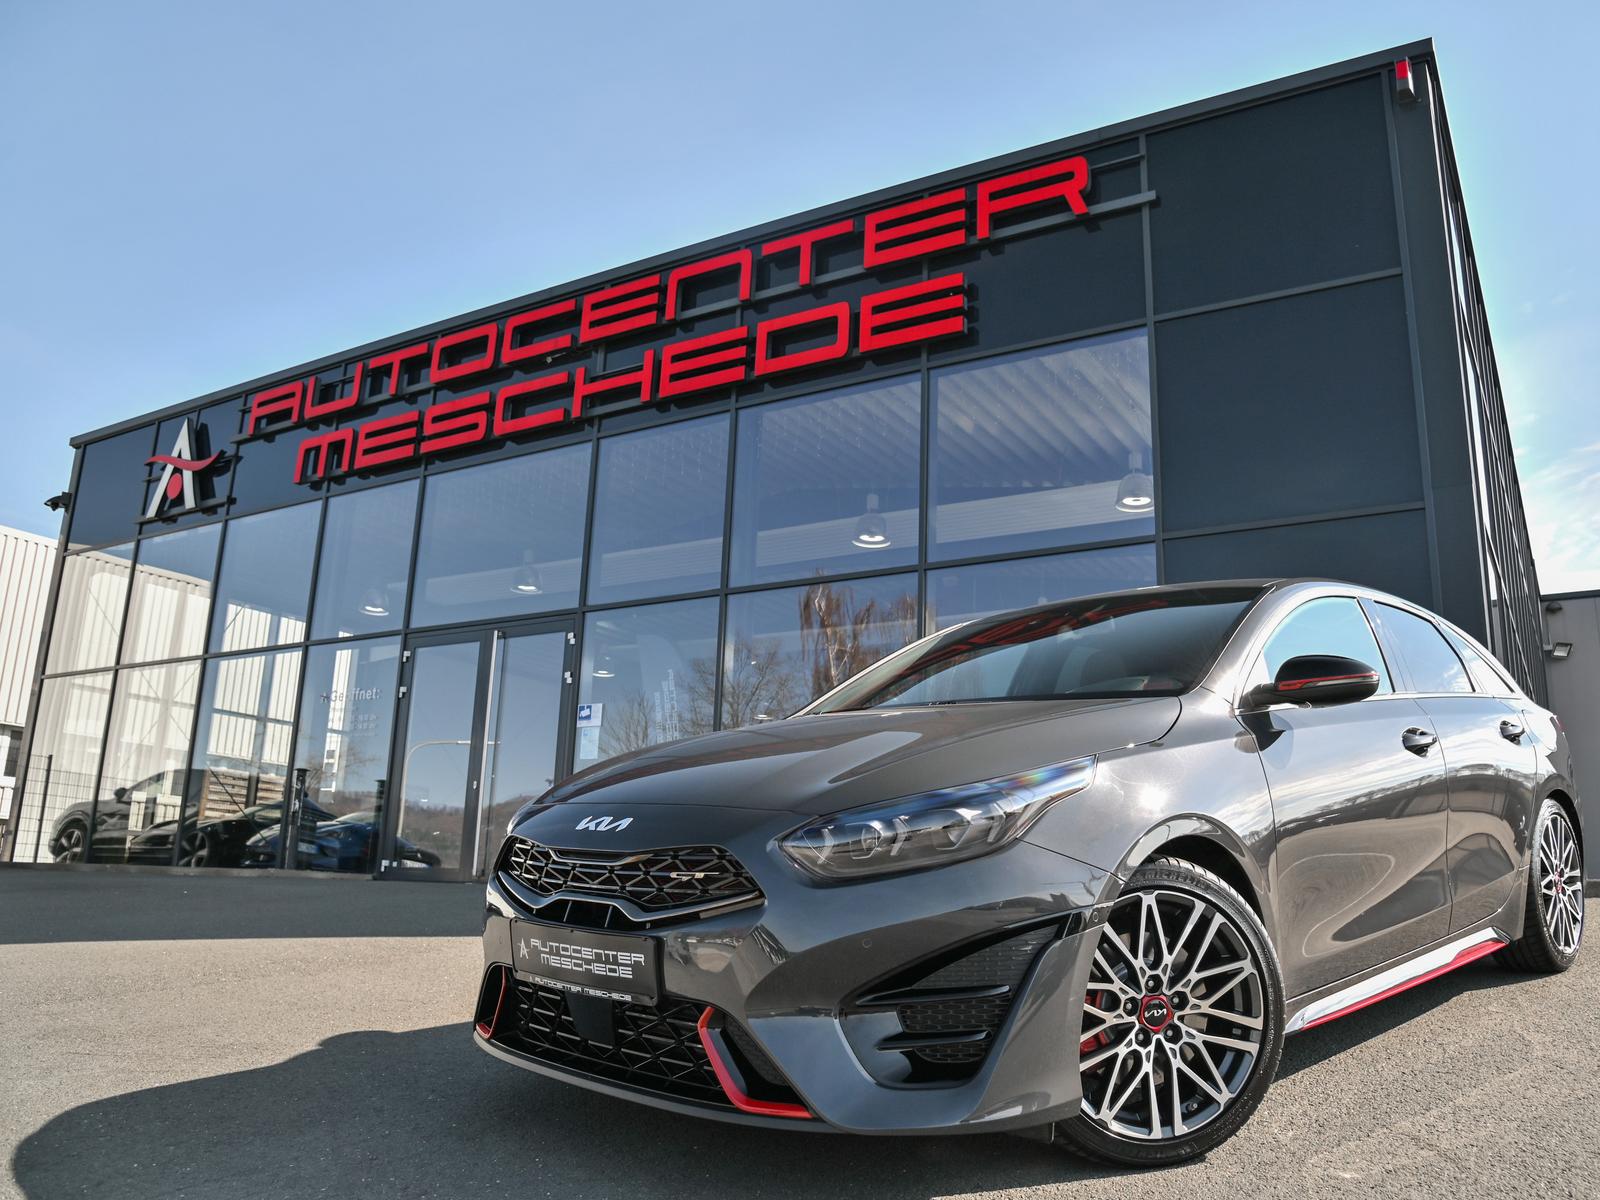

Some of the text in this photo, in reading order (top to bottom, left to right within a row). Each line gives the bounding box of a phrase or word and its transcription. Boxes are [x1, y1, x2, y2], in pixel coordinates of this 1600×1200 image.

[247, 156, 1088, 436] AUTOCENTER
[292, 272, 964, 484] MESCHEDE
[575, 815, 634, 832] KIA
[530, 938, 645, 966] AUTOCENTER
[540, 953, 633, 979] MESCHEDE
[534, 977, 582, 993] AUTOCENTER
[584, 987, 632, 1002] MESCHEDE
